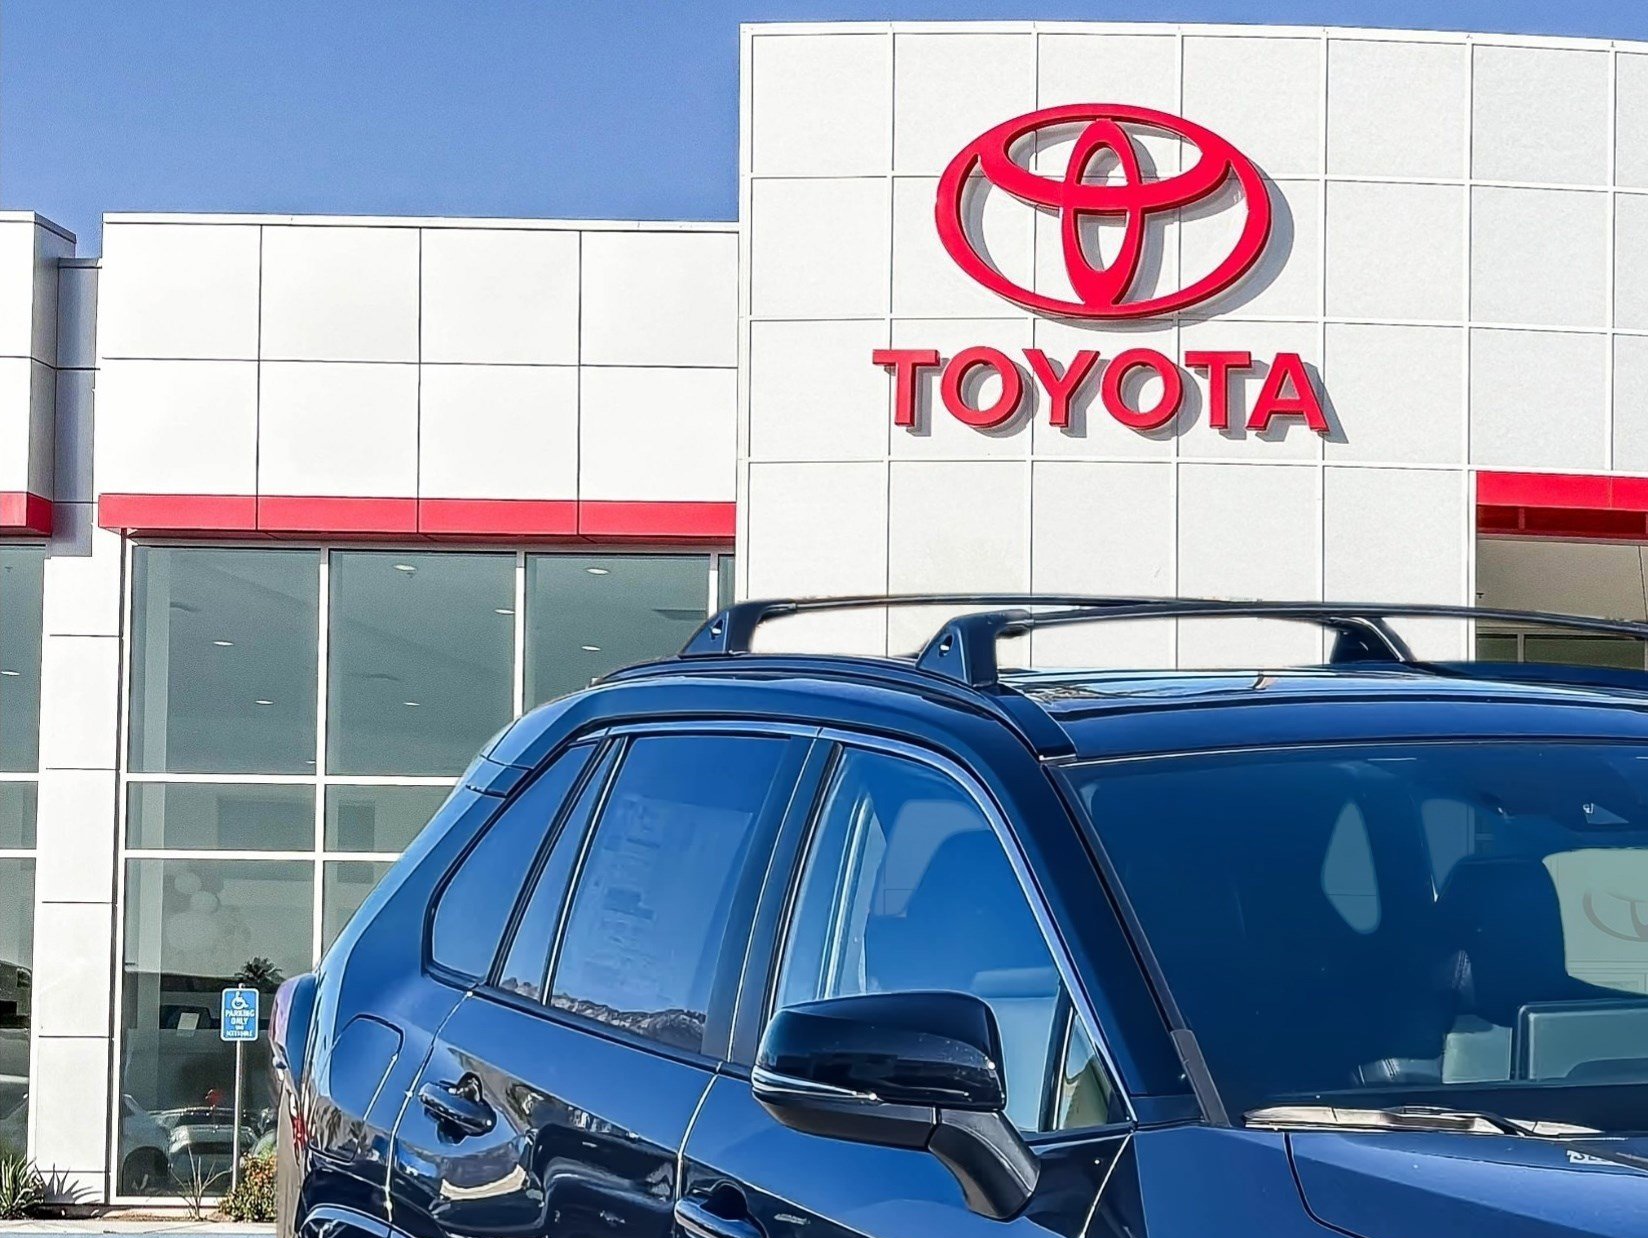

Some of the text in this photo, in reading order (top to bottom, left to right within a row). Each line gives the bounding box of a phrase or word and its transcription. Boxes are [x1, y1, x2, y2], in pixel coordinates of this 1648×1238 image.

[872, 346, 1330, 434] TOYOTA
[224, 1009, 255, 1018] PARKING
[230, 1017, 249, 1025] ONLY
